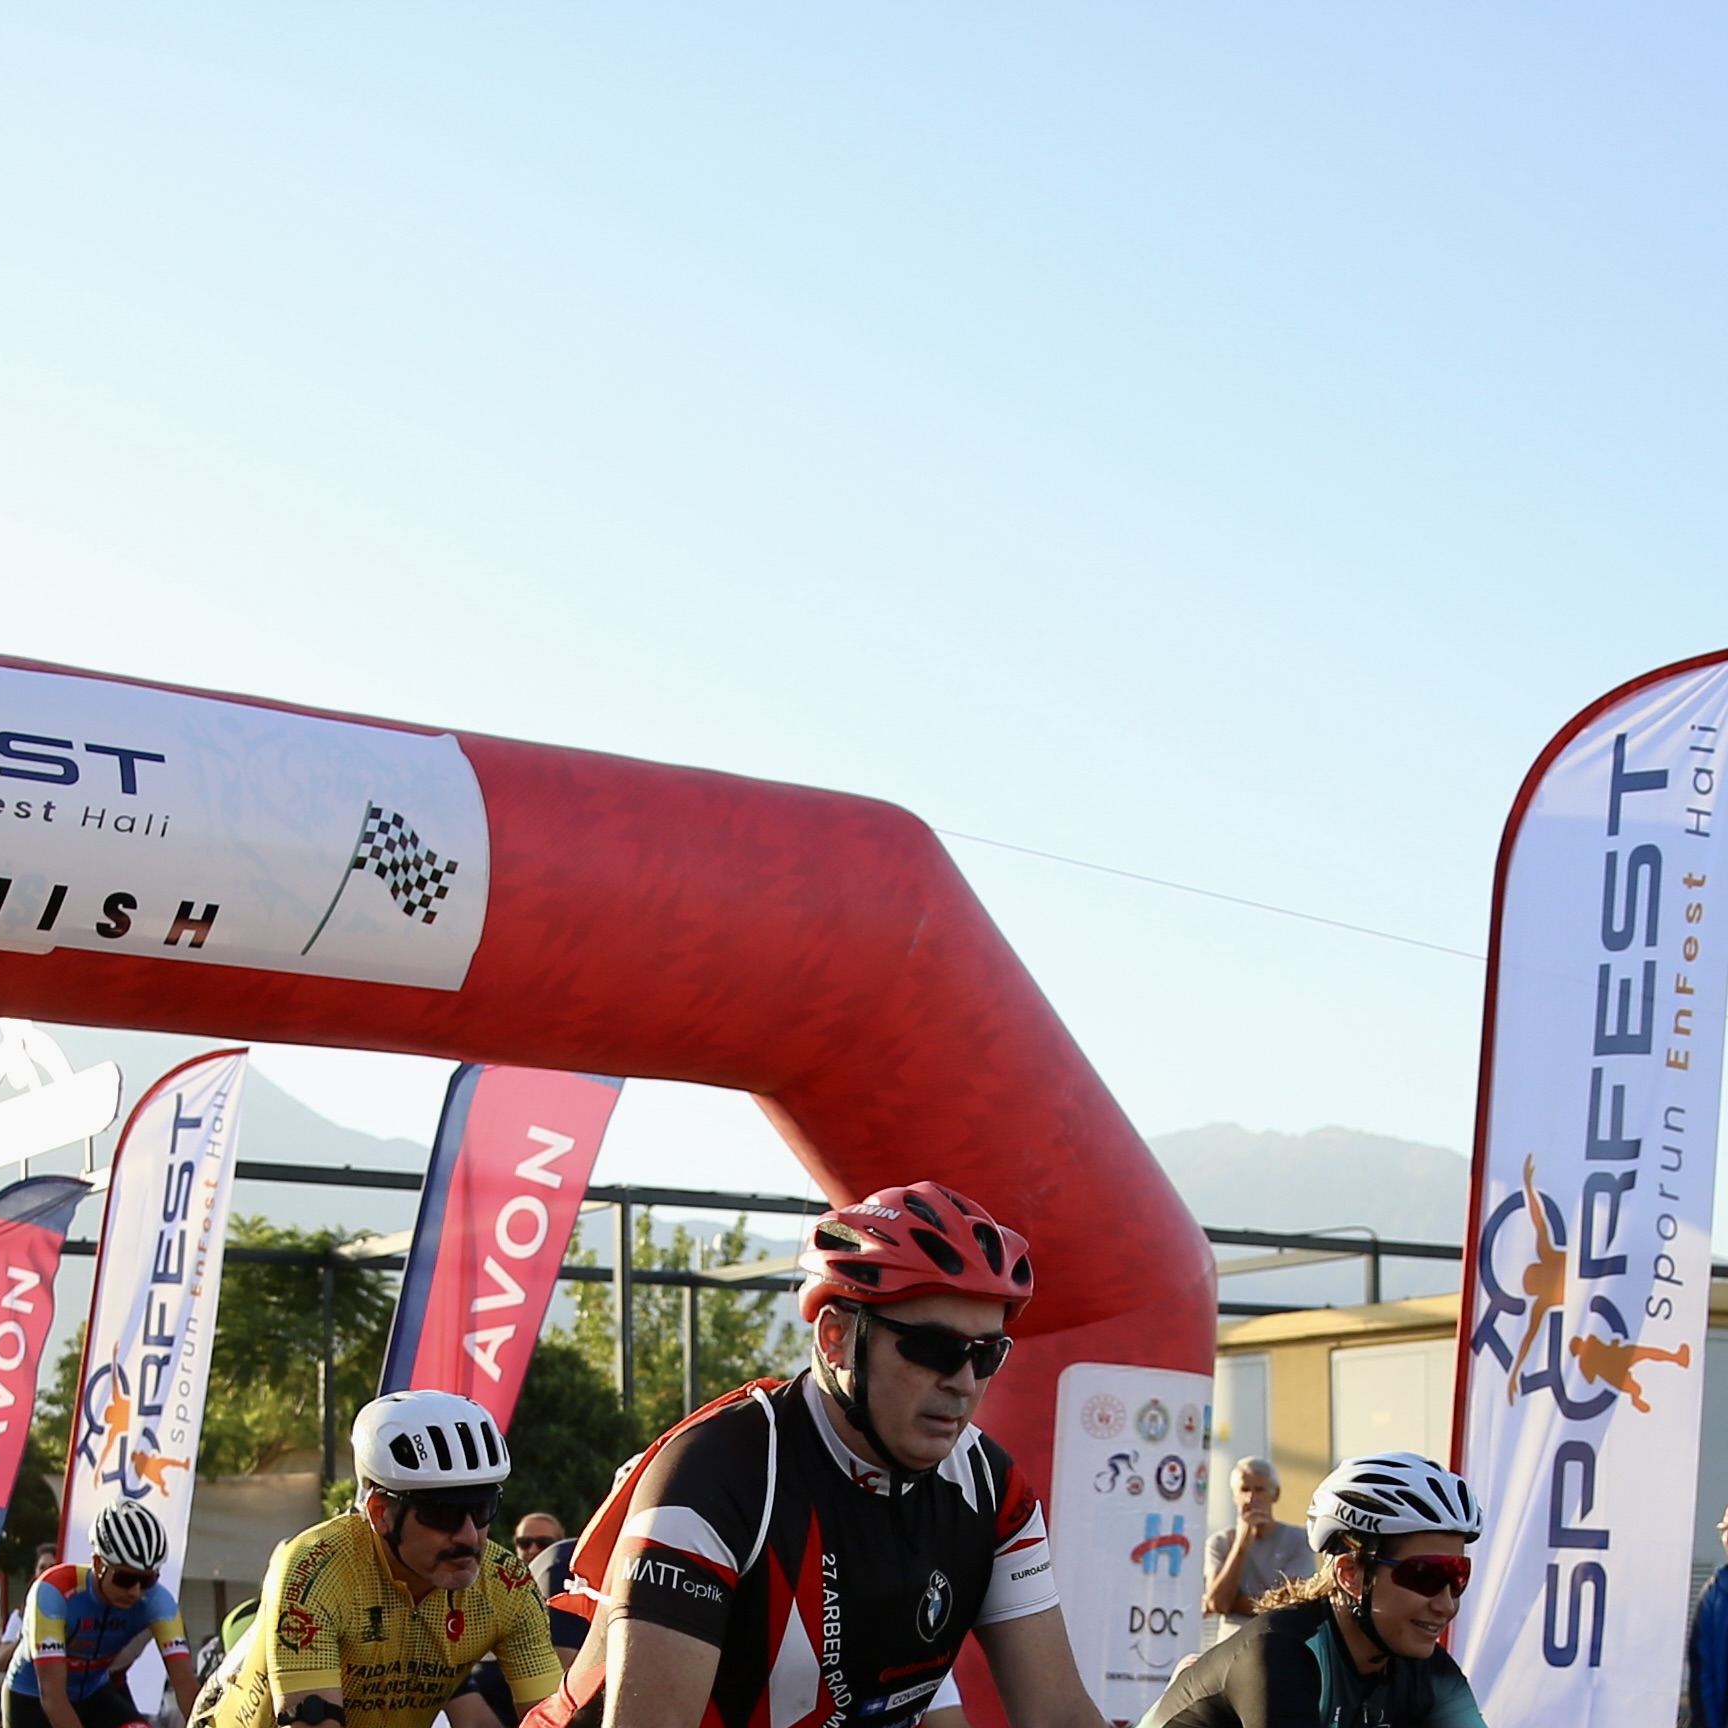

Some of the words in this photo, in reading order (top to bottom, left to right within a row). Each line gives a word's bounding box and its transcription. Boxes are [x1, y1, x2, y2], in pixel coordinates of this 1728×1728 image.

[81, 804, 171, 840] Hali
[1684, 723, 1718, 838] Hali
[1665, 871, 1709, 1071] EnFest
[462, 1125, 576, 1382] AVON
[1543, 732, 1670, 1669] SPORFEST
[1644, 1103, 1687, 1321] Sporun
[170, 1310, 200, 1445] Sporun
[191, 1177, 219, 1298] EnFest
[206, 1090, 228, 1158] Hali
[1335, 1500, 1383, 1534] KASK
[621, 1555, 686, 1592] MATT
[682, 1577, 725, 1604] optik
[821, 1552, 842, 1668] 27.ARBER
[1129, 1605, 1184, 1636] DOC
[824, 1669, 853, 1709] RAD
